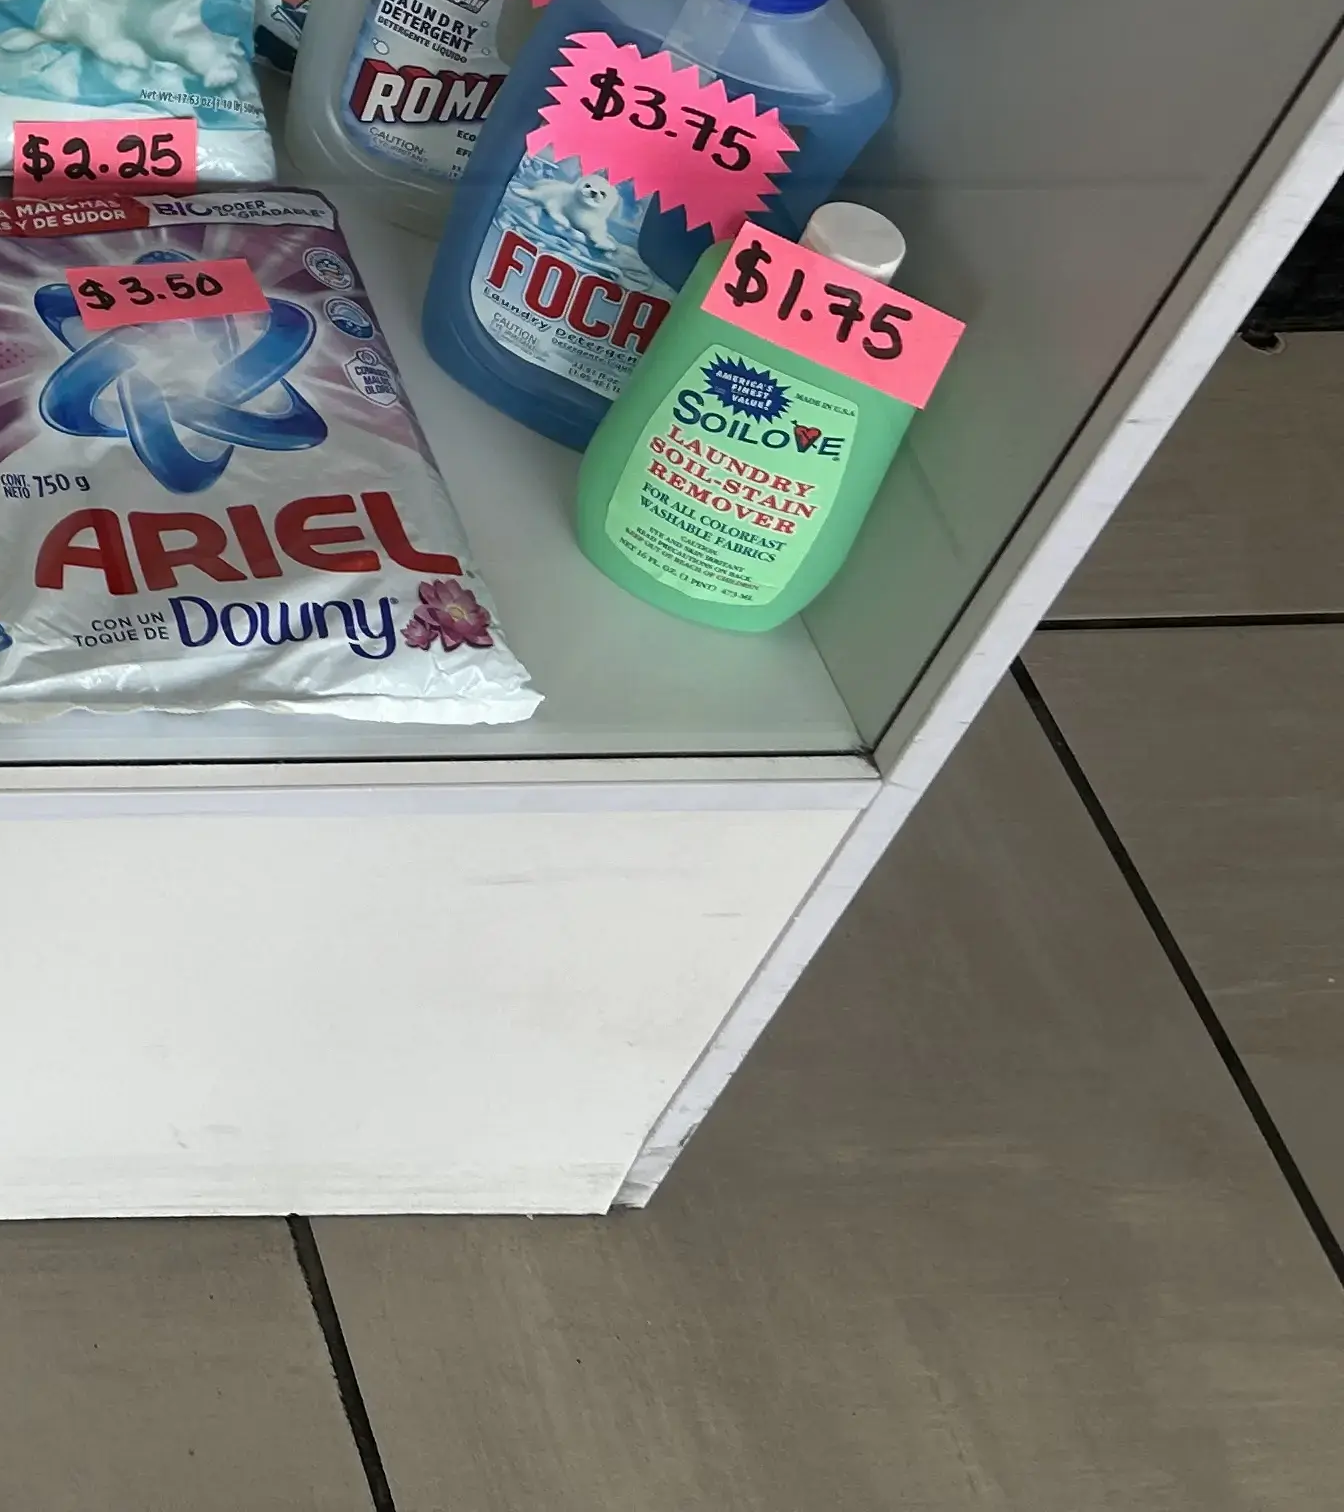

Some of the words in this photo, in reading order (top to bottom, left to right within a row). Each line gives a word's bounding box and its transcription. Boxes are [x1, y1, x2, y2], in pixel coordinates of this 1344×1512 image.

[378, 16, 430, 47] DETERGENTE
[432, 43, 467, 63] LÍQUIDO
[381, 1, 473, 53] DETERGENT
[581, 67, 756, 172] $3.75
[22, 134, 183, 182] $2.25
[33, 216, 57, 229] DE
[63, 209, 126, 226] SUDOR
[78, 271, 223, 311] $3.50
[484, 288, 551, 332] Laundry
[486, 231, 670, 354] FOCA
[724, 240, 912, 360] $1.75
[716, 370, 774, 393] AMERICA'S
[731, 383, 770, 399] FINEST
[33, 476, 72, 497] 750
[650, 436, 817, 518] SOIL-STAIN
[668, 423, 815, 498] LAUNDRY
[642, 482, 668, 504] FOR
[670, 499, 695, 521] ALL
[700, 515, 787, 551] COLORFAST
[647, 459, 796, 535] REMOVER
[35, 491, 462, 594] ARIEL
[640, 496, 711, 541] WASHABLE
[714, 536, 776, 563] FABRICS
[73, 631, 140, 648] TOQUE
[146, 626, 169, 641] DE
[93, 616, 134, 632] CON
[139, 612, 164, 626] UN
[169, 596, 393, 658] Downy
